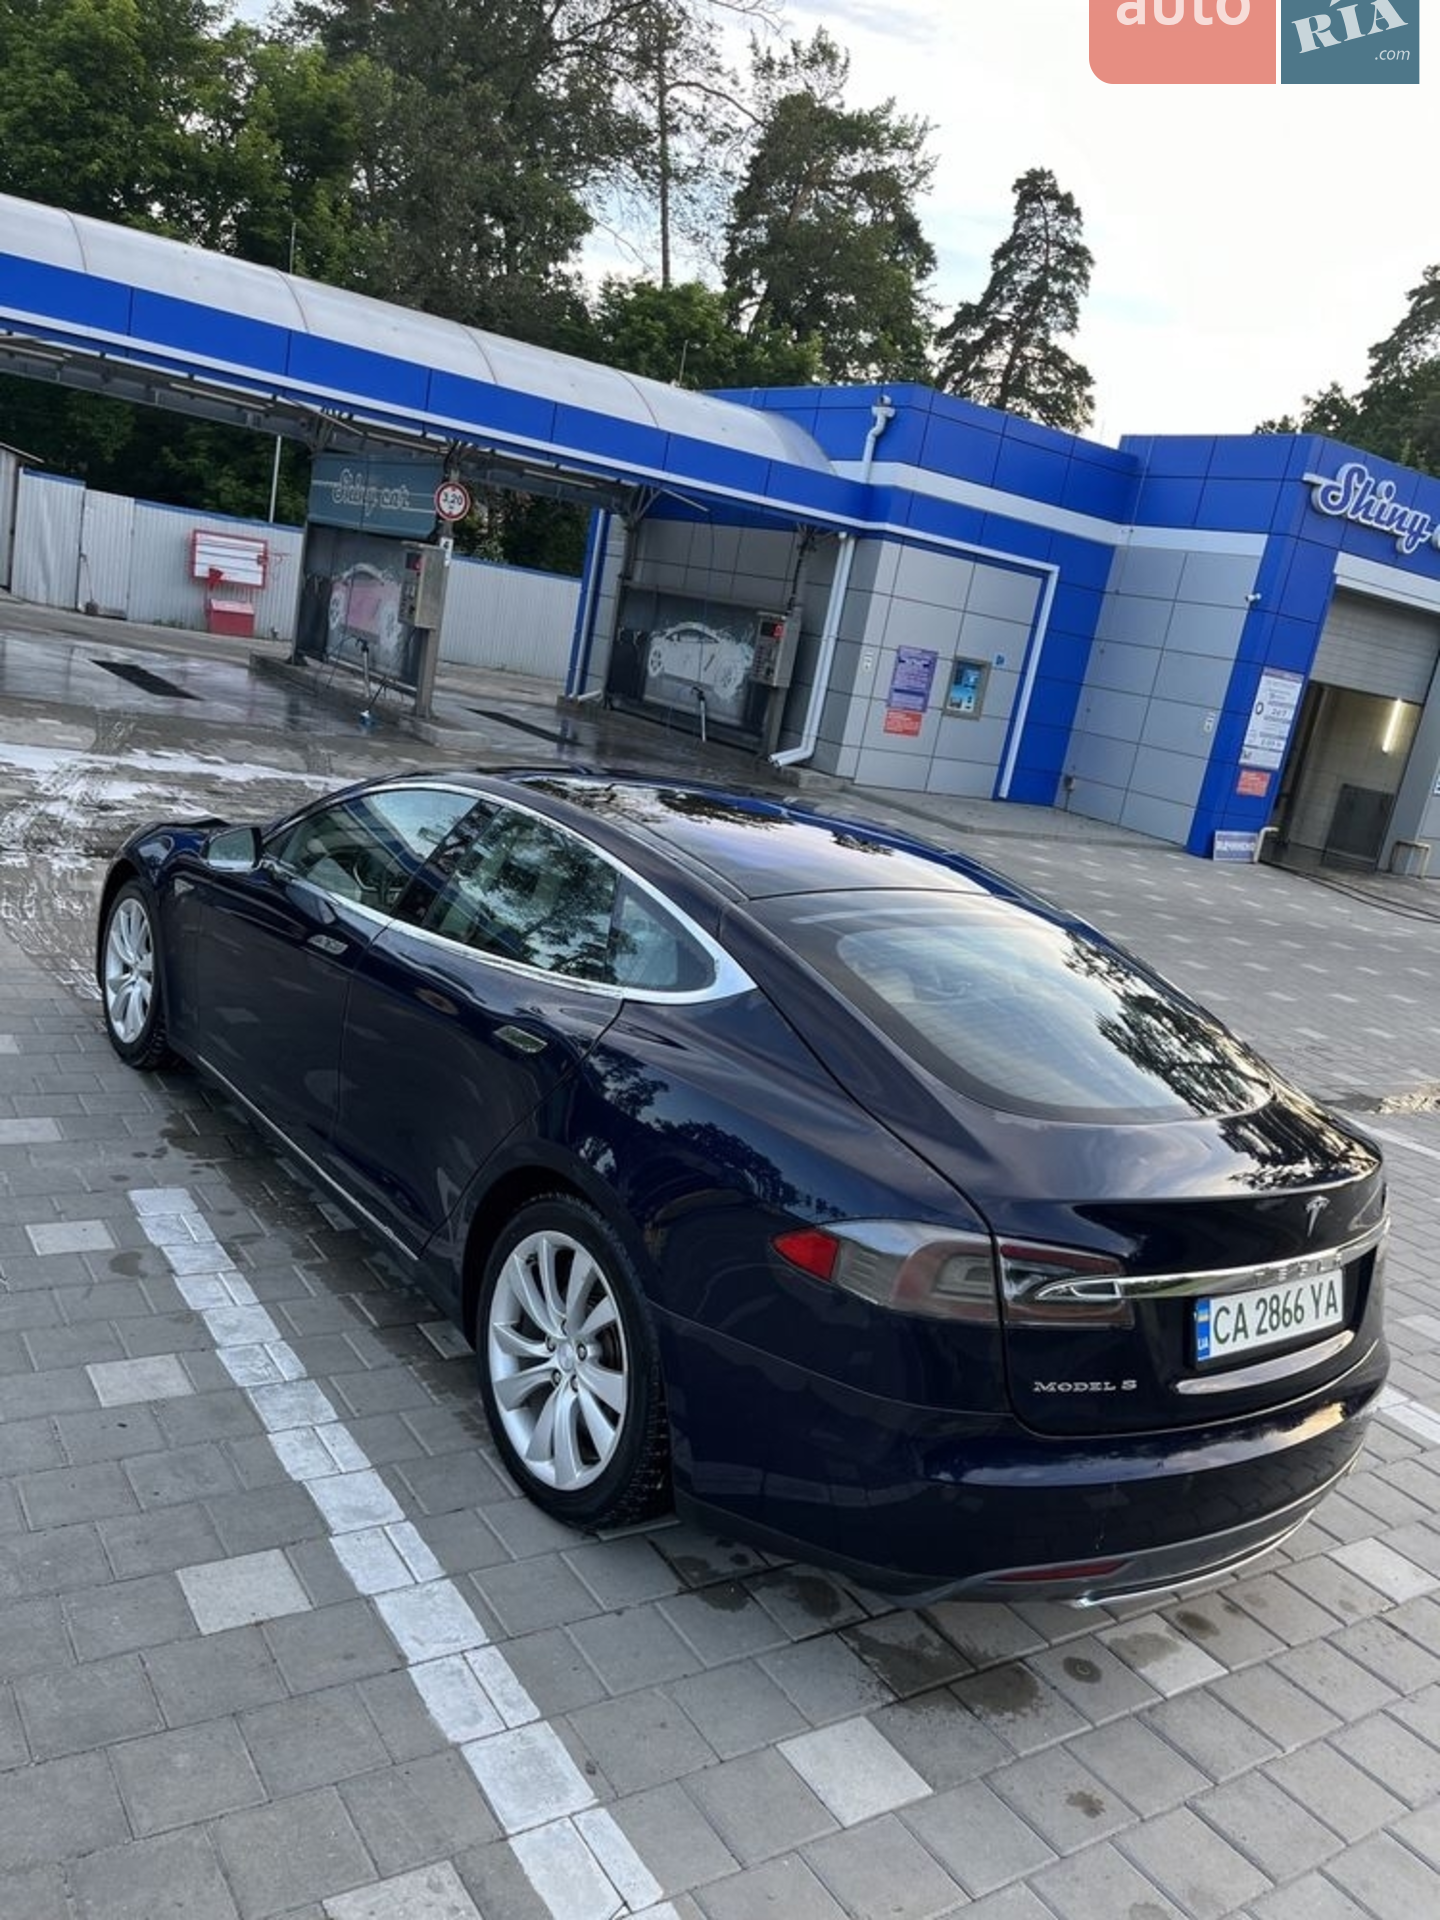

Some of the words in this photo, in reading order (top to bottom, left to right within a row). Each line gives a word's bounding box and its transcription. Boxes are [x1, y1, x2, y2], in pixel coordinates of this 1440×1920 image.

[1312, 463, 1431, 554] Shiny
[1213, 1302, 1249, 1344] CA
[1255, 1288, 1305, 1336] 2866
[1310, 1279, 1338, 1320] YA
[1033, 1381, 1117, 1392] MODEL
[1121, 1379, 1137, 1391] S
